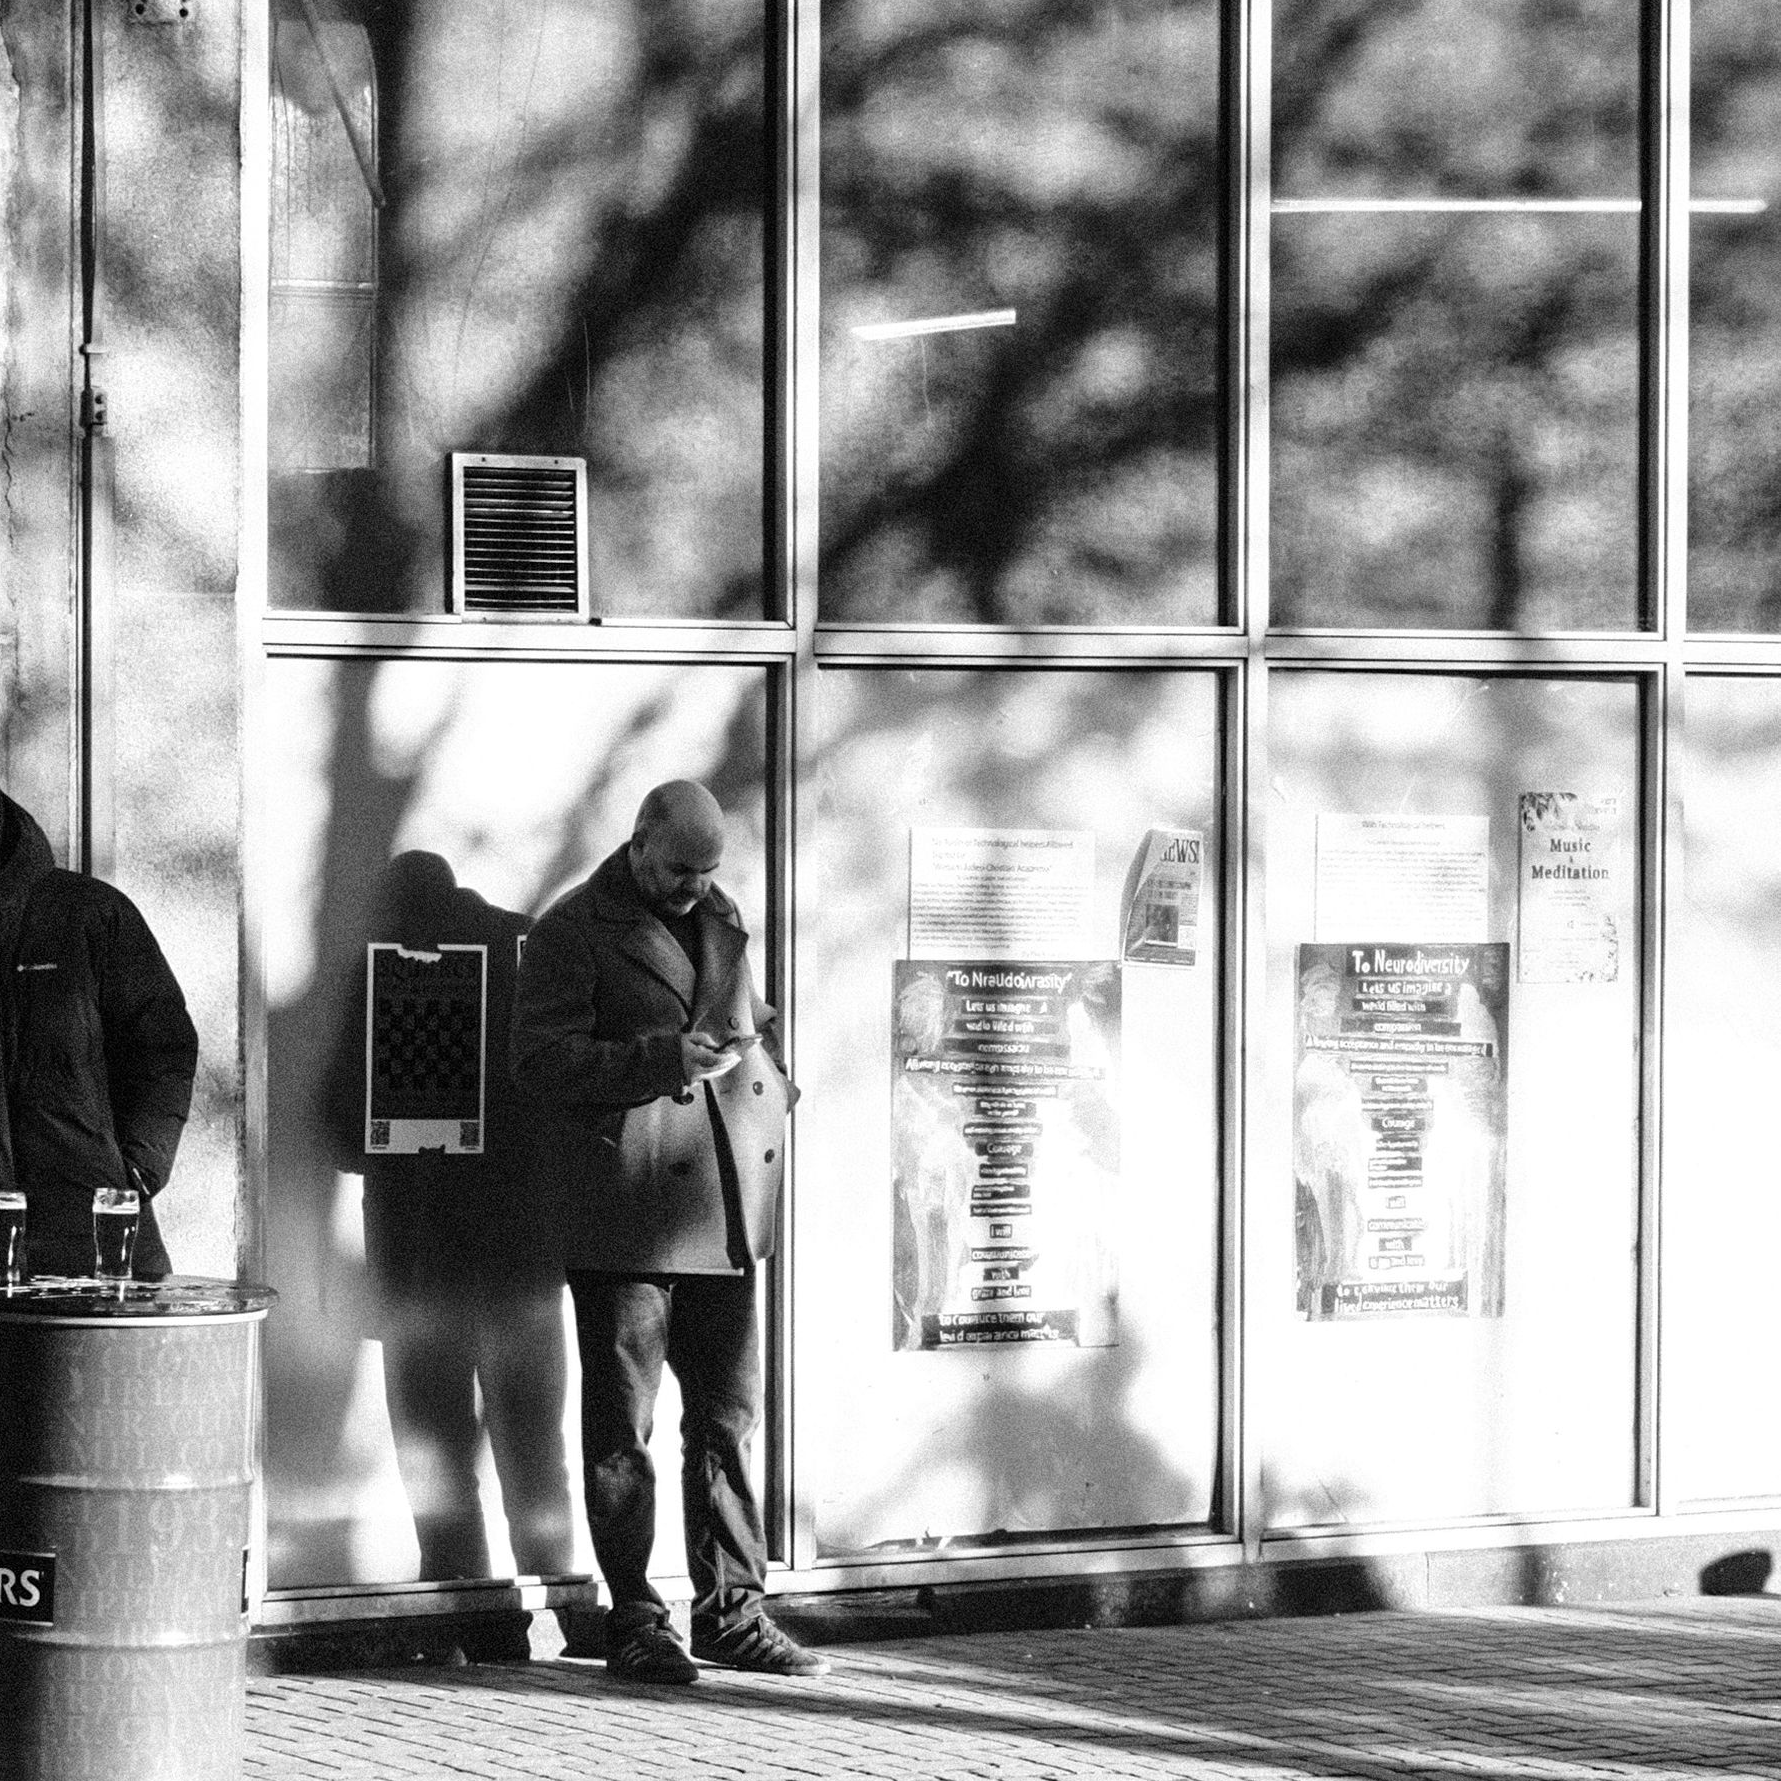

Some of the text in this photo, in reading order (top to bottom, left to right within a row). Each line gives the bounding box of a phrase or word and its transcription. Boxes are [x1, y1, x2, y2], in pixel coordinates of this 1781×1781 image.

[1550, 836, 1592, 853] Music
[1531, 863, 1610, 880] Meditation
[1352, 949, 1471, 976] To Neurodiversity
[1387, 982, 1403, 994] us
